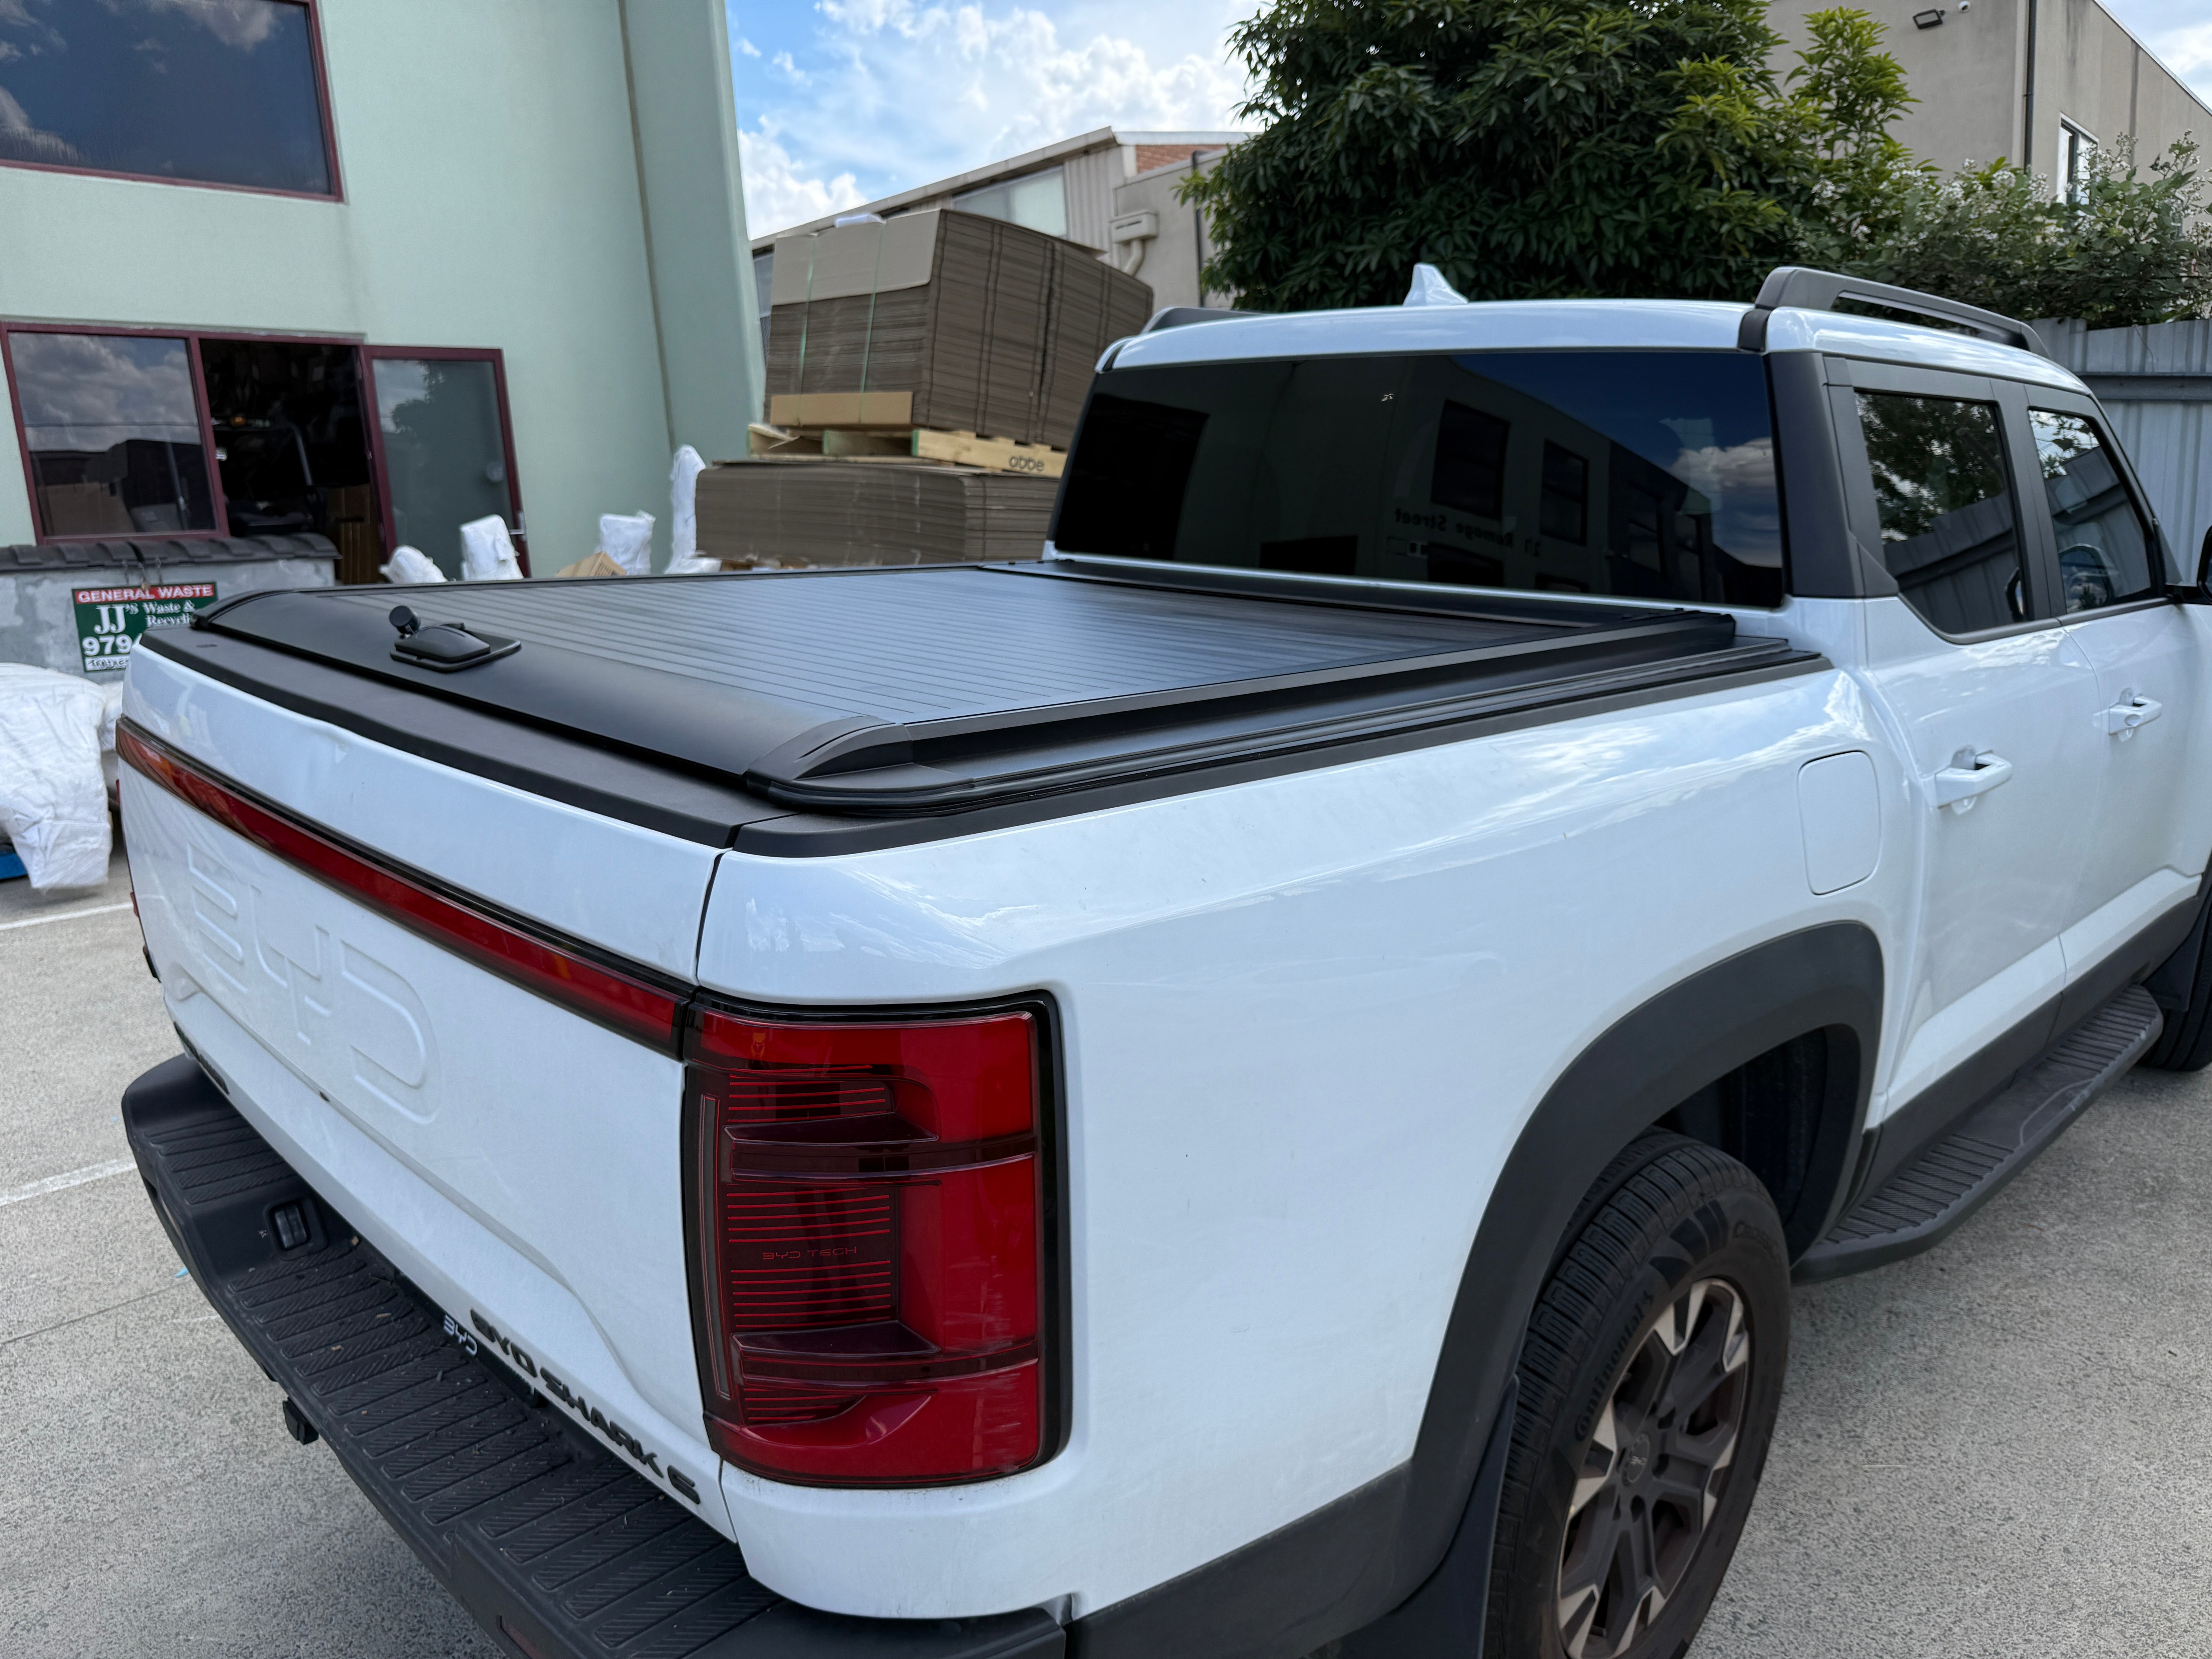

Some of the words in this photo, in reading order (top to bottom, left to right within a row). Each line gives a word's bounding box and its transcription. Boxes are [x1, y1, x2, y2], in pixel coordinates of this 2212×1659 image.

[1009, 456, 1044, 471] abbe
[78, 588, 155, 603] GENERAL
[157, 584, 214, 599] WASTE
[141, 601, 181, 615] Waste
[183, 599, 196, 613] &
[145, 613, 191, 628] Recycli
[82, 634, 133, 656] 979
[763, 1250, 801, 1260] BYD
[807, 1246, 857, 1257] TECH
[443, 1314, 478, 1357] BYD
[1574, 1302, 1644, 1441] Continental
[471, 1309, 538, 1378] BYD
[540, 1367, 664, 1479] SHARK
